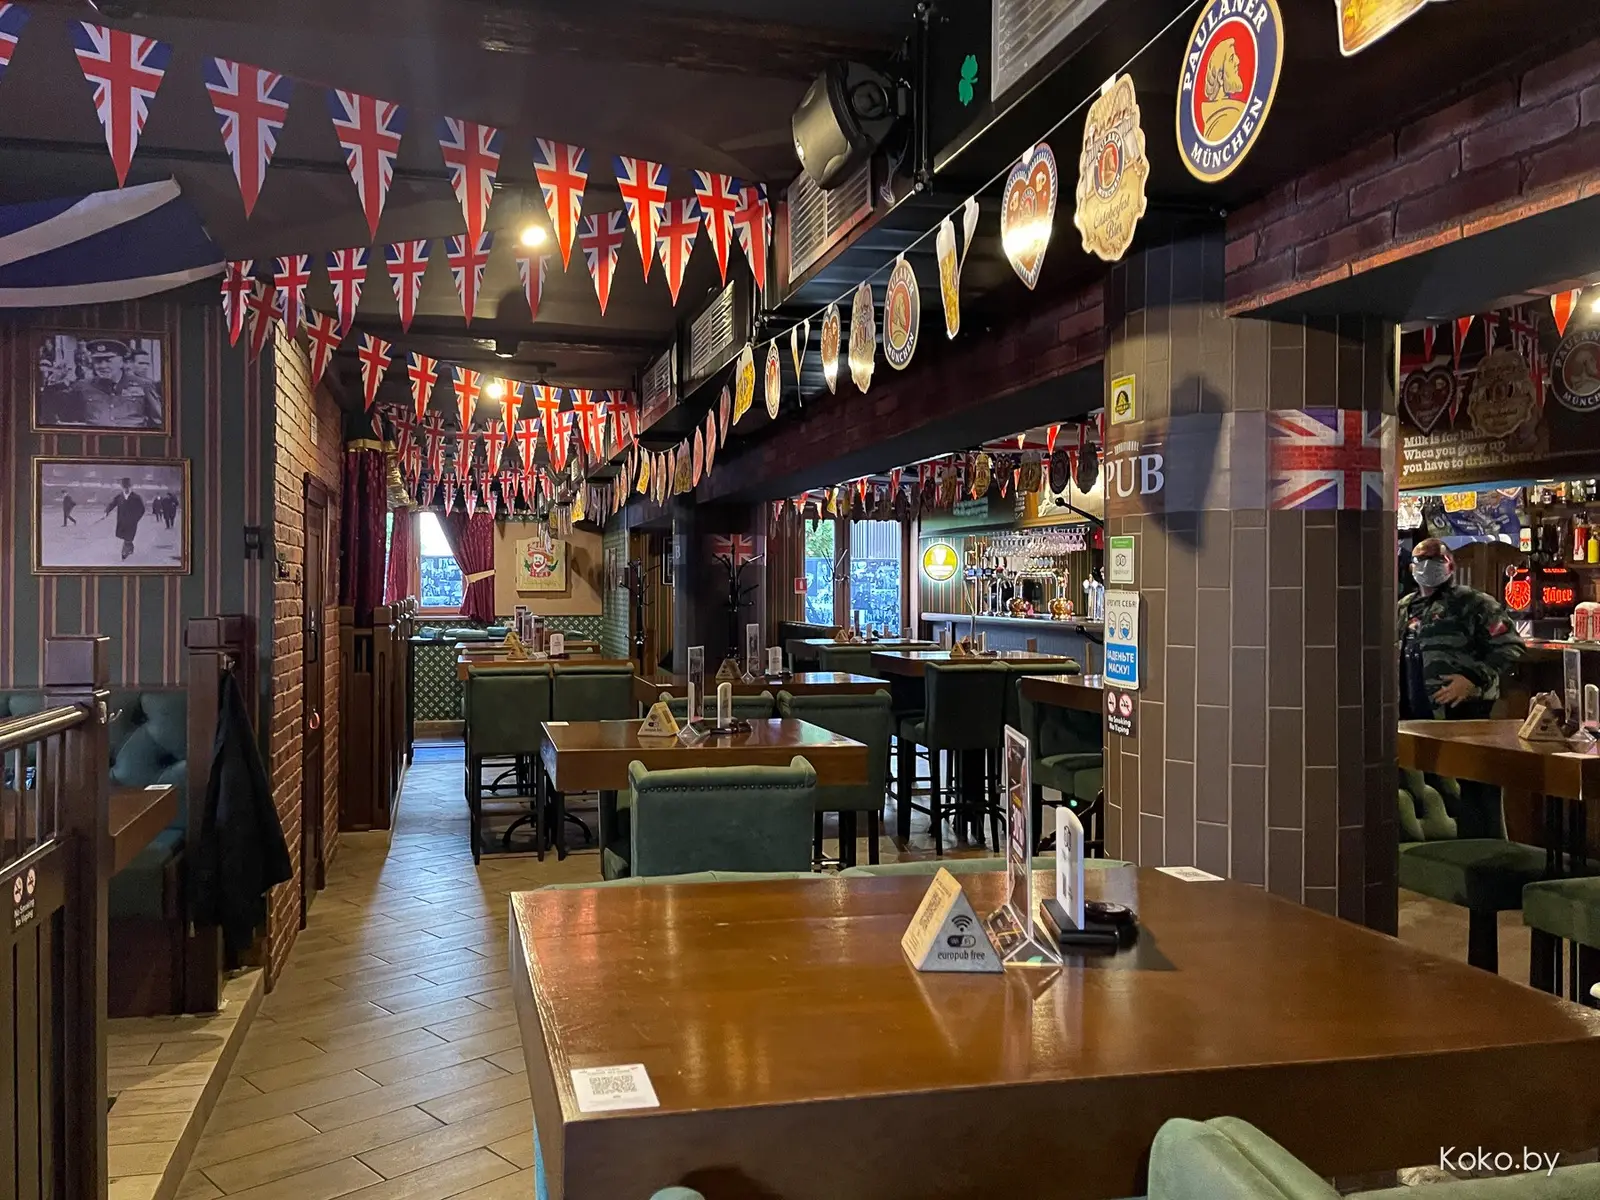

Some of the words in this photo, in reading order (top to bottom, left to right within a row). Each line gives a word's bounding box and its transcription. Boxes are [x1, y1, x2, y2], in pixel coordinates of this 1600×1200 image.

[1182, 0, 1269, 92] PAULANER
[1190, 97, 1264, 169] MÜNCHEN
[887, 333, 915, 363] MÜNCHEN
[1403, 435, 1428, 448] Milk
[1429, 433, 1440, 445] is
[1441, 432, 1458, 444] for
[1403, 448, 1434, 461] When
[1435, 447, 1457, 460] you
[1457, 443, 1488, 456] grow
[1402, 463, 1424, 477] you
[1423, 459, 1449, 473] have
[1451, 458, 1464, 469] to
[1465, 454, 1501, 468] drink
[1105, 454, 1164, 499] PUB
[1542, 586, 1573, 604] Jäger
[1108, 662, 1130, 676] МАСКУ!
[1113, 715, 1131, 728] Smoking
[937, 950, 969, 962] europub
[970, 950, 985, 960] free
